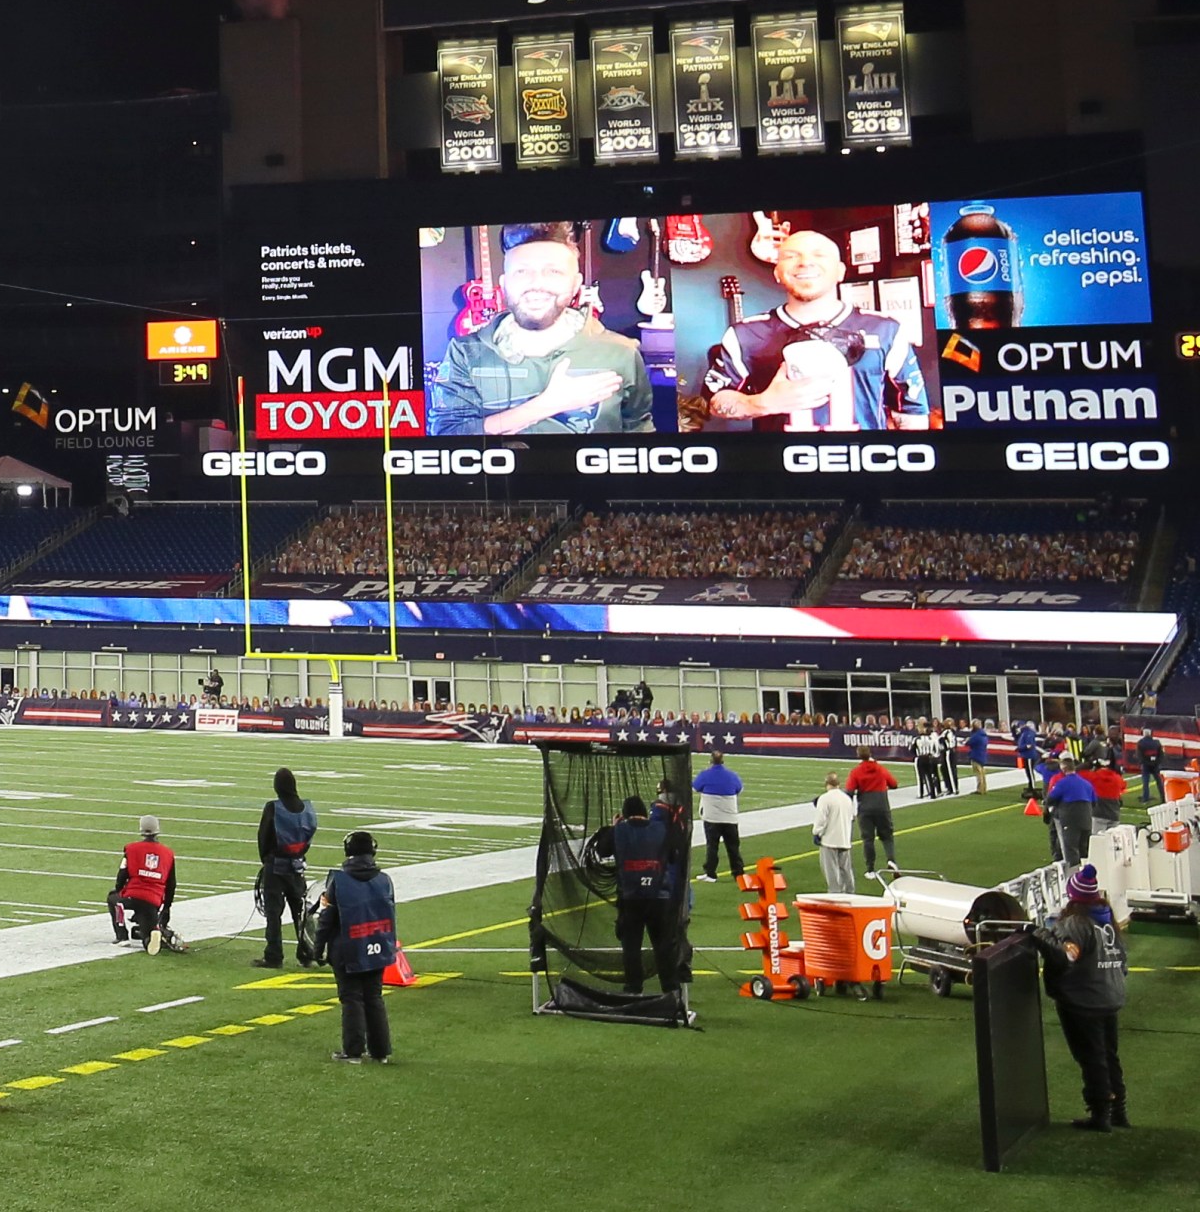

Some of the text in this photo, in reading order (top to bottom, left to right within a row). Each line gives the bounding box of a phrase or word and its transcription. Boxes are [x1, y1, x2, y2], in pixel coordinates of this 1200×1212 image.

[777, 47, 812, 55] ENGLAND
[863, 41, 898, 49] ENGLAND
[695, 54, 729, 62] ENGLAND
[850, 49, 892, 58] PATRIOTS
[614, 61, 648, 69] ENGLAND
[683, 62, 724, 72] PATRIOTS
[765, 56, 807, 66] PATRIOTS
[525, 75, 563, 84] PATRIOTS
[603, 68, 642, 78] PATRIOTS
[449, 81, 486, 90] PATRIOTS
[686, 101, 724, 113] XLIX
[771, 107, 806, 116] WORLD
[856, 100, 892, 110] WORLD
[688, 114, 722, 123] WORLD
[762, 115, 817, 126] CHAMPIONS
[847, 109, 903, 120] CHAMPIONS
[529, 124, 561, 133] WORLD
[608, 119, 640, 128] WORLD
[680, 122, 733, 132] CHAMPIONS
[851, 117, 901, 133] 2018
[453, 130, 485, 138] WORLD
[521, 132, 570, 143] CHAMPIONS
[599, 127, 651, 137] CHAMPIONS
[684, 131, 731, 146] 2014
[766, 125, 815, 140] 2016
[446, 138, 494, 147] CHAMPIONS
[523, 141, 570, 156] 2003
[600, 136, 651, 152] 2004
[449, 146, 492, 160] 2001
[1043, 228, 1139, 247] delicious.
[261, 243, 355, 258] Patriots tickets,
[1029, 247, 1141, 267] refreshing.
[261, 257, 365, 271] concerts & more.
[1001, 248, 1012, 282] pepsi
[1081, 267, 1143, 288] pepsi.
[998, 340, 1142, 371] OPTUM
[173, 363, 208, 382] 3:49
[268, 346, 409, 393] MGM
[942, 385, 1158, 422] Putnam
[55, 407, 156, 433] OPTUM
[261, 399, 419, 431] TOYOTA
[55, 435, 154, 449] FIELD LOUNGE
[383, 449, 515, 475] GEICO
[576, 446, 718, 474] GEICO
[783, 443, 935, 474] GEICO
[1005, 441, 1170, 471] GEICO
[202, 451, 327, 476] GEICO
[343, 580, 488, 597] PATR
[528, 582, 665, 602] IOTS
[860, 589, 1082, 604] Gllette
[198, 713, 236, 725] ESPN
[641, 877, 652, 886] 27
[349, 919, 393, 939] ESPN
[767, 904, 781, 975] GATORADE
[863, 918, 887, 960] G
[367, 943, 381, 955] 20
